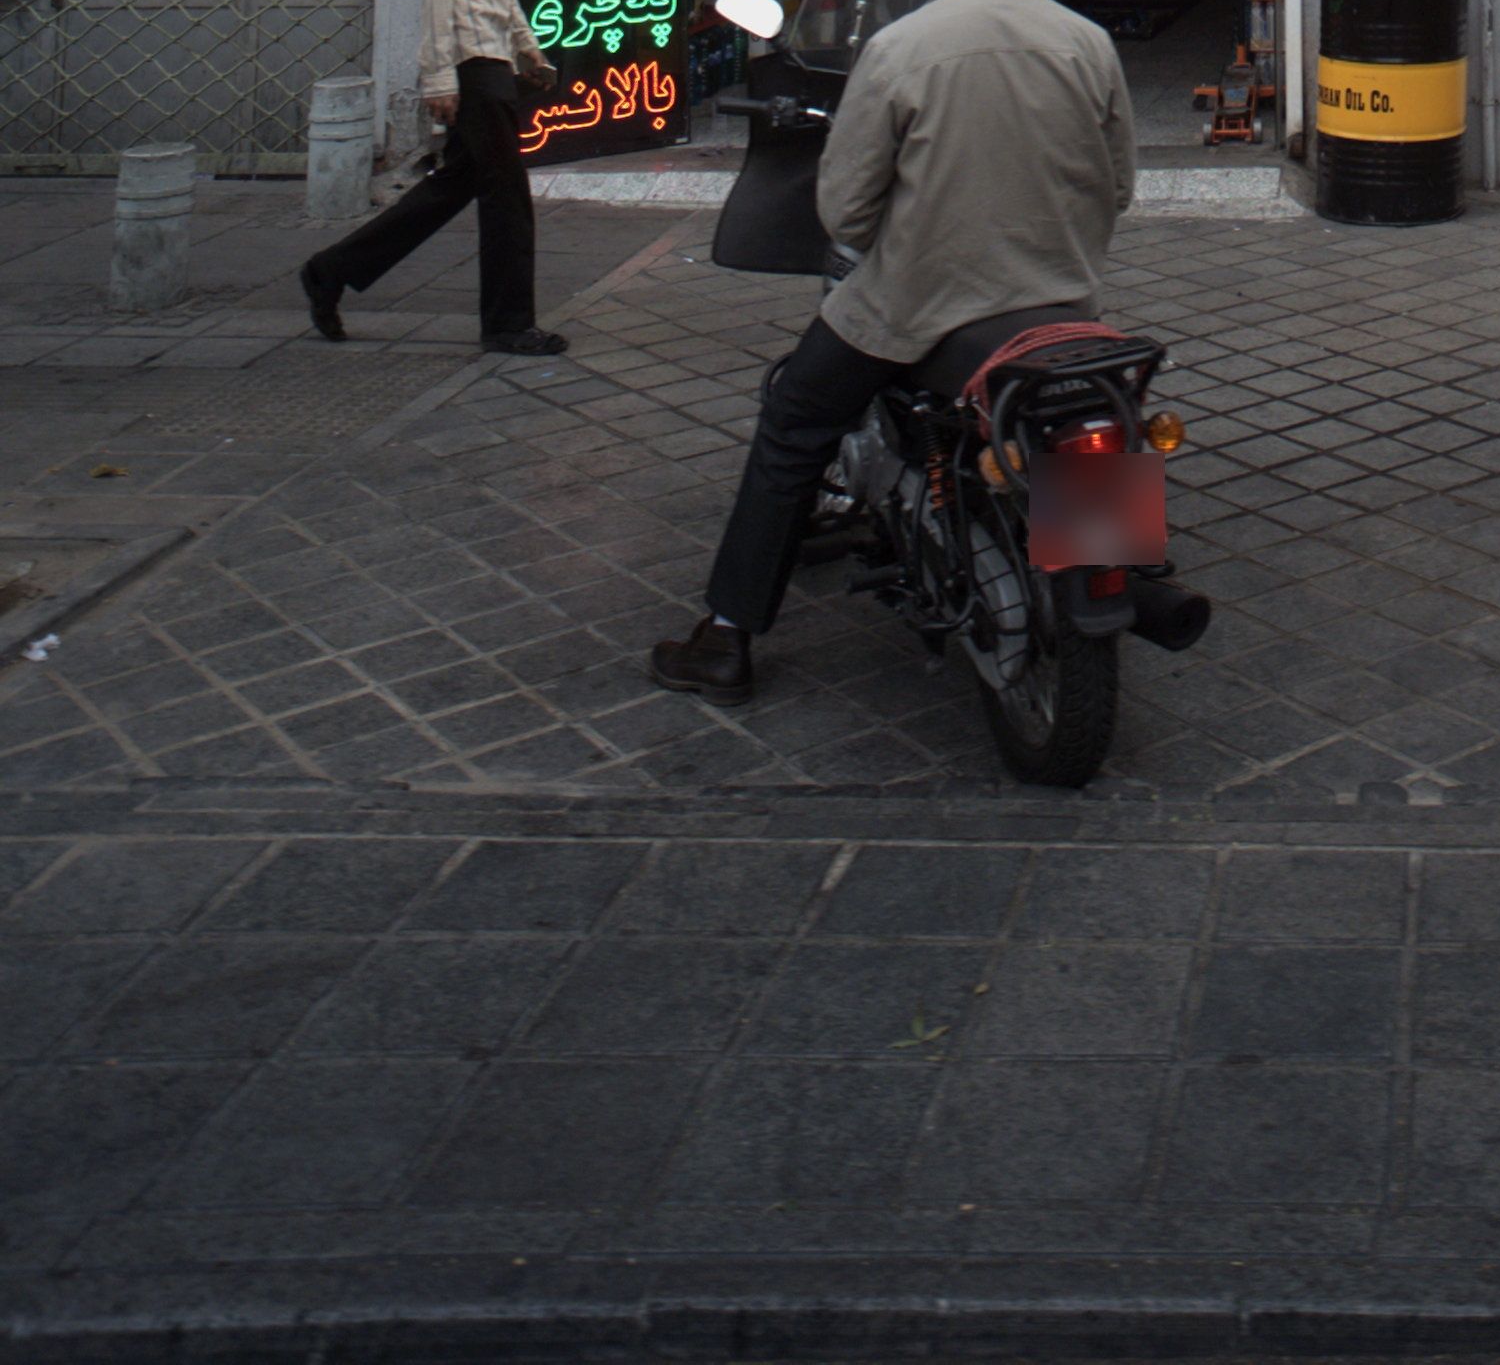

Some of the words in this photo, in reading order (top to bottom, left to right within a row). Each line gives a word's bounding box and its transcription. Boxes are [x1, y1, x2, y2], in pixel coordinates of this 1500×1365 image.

[518, 60, 677, 154] بالانس
[1345, 87, 1365, 111] OIL
[1370, 90, 1394, 113] Co.
